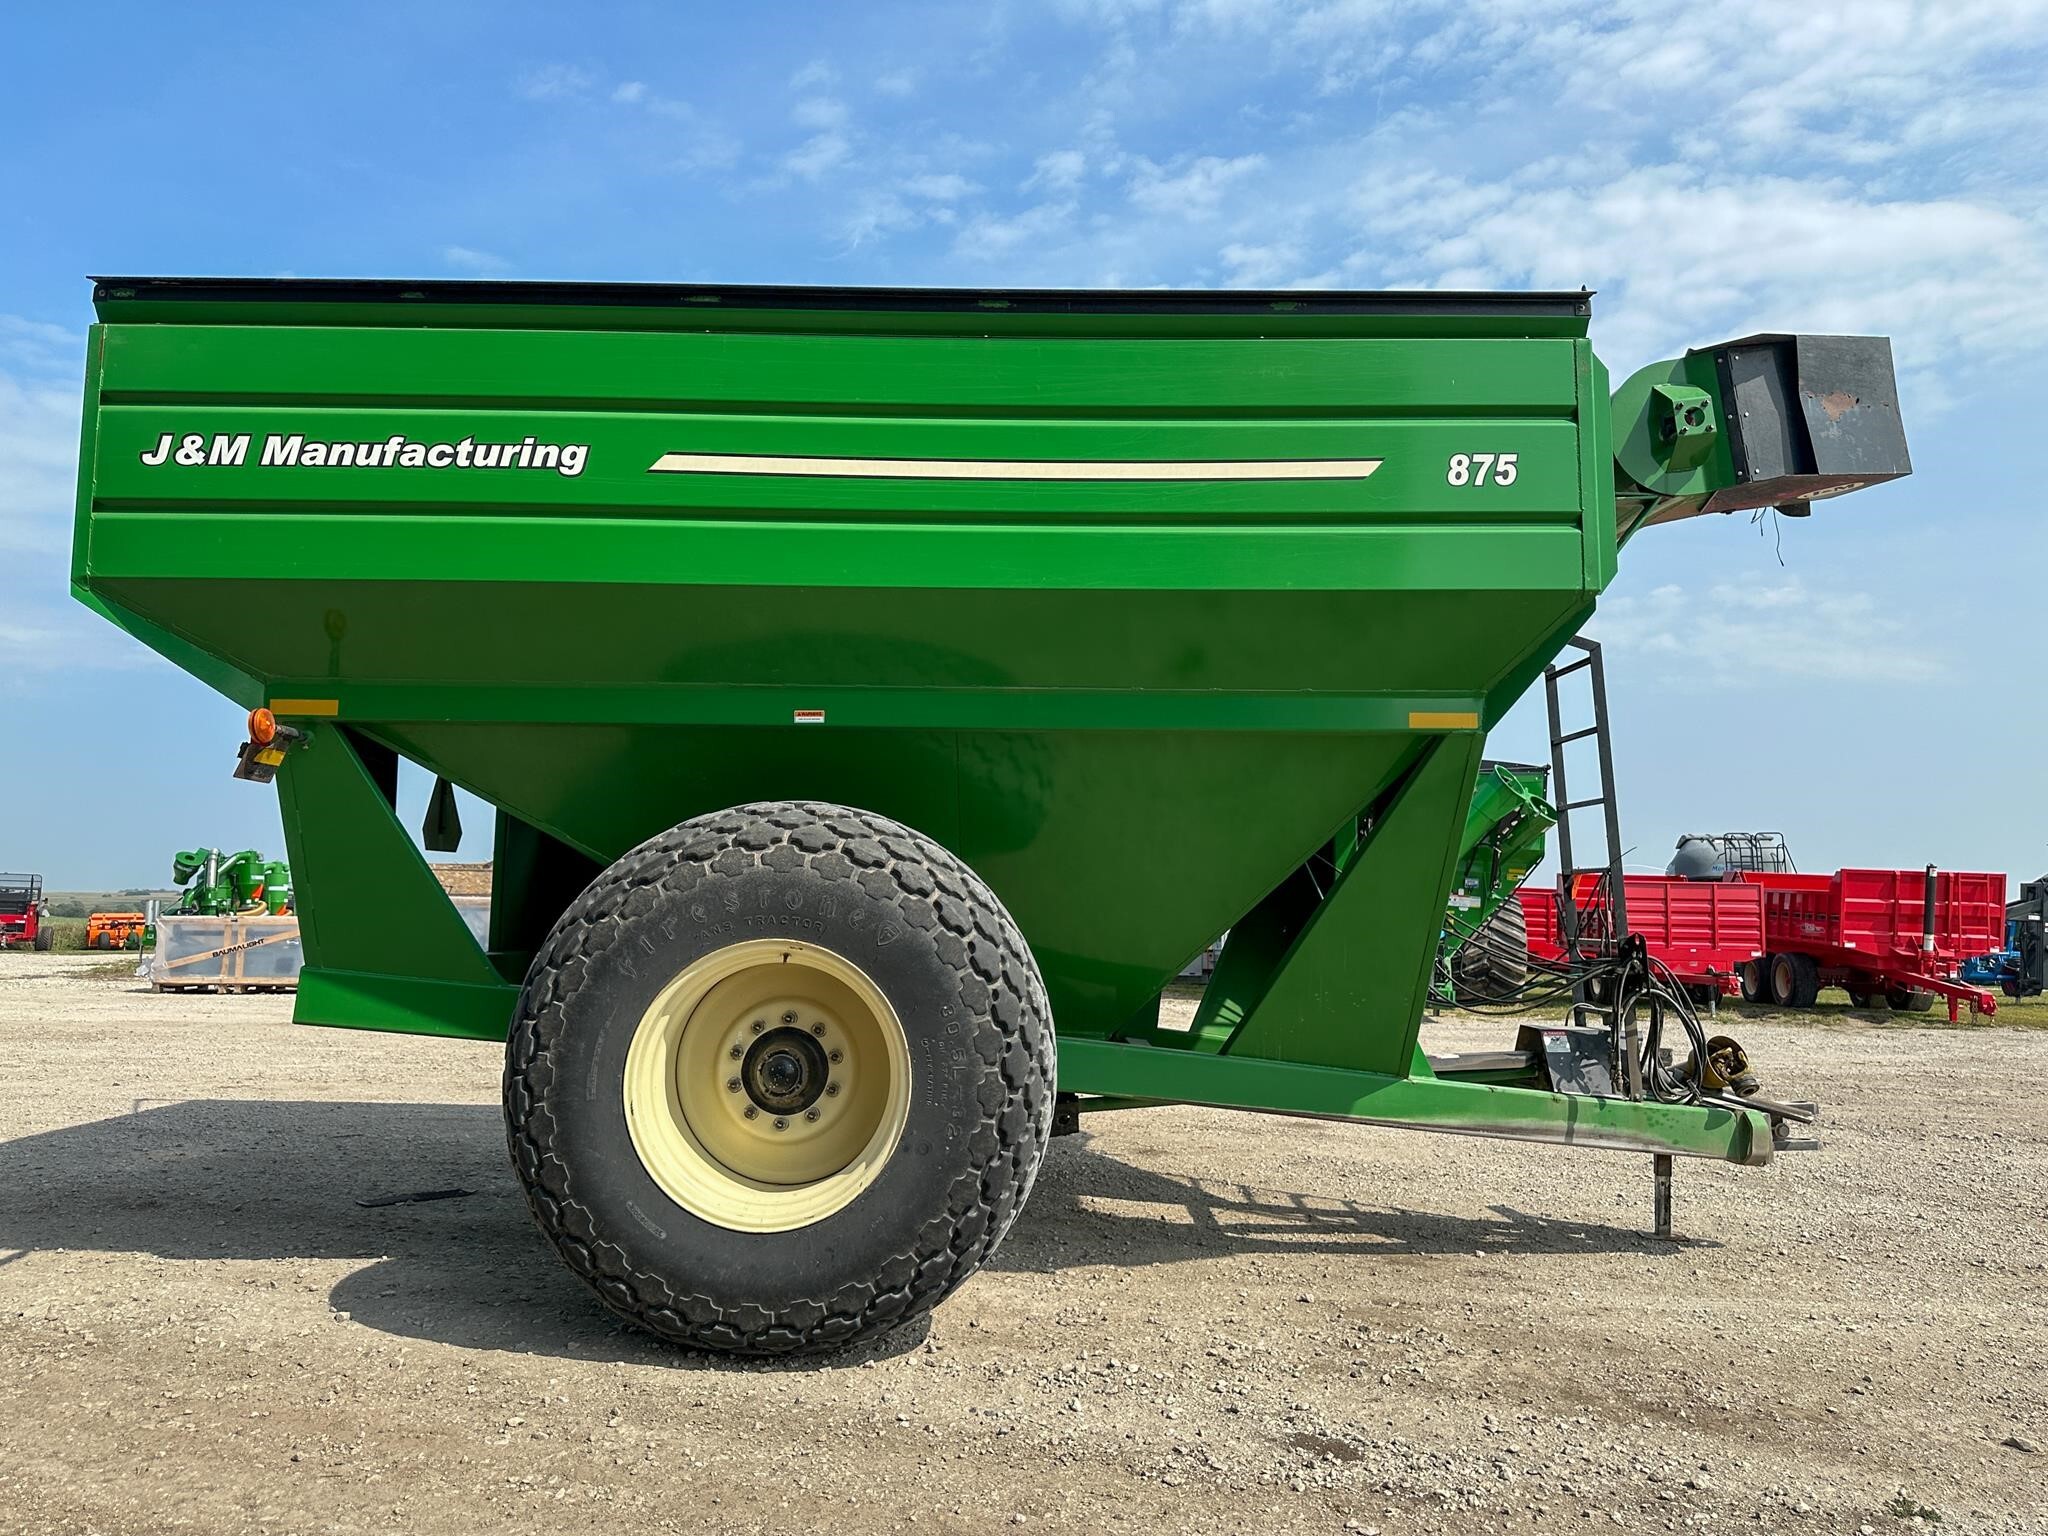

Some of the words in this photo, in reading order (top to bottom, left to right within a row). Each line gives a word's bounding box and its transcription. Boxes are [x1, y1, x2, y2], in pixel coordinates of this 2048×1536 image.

[140, 432, 251, 467] J&M
[258, 434, 592, 477] Manufacturing
[1446, 452, 1519, 487] 875
[744, 914, 826, 934] TRACTOR
[212, 938, 264, 957] BAUMALIGHT
